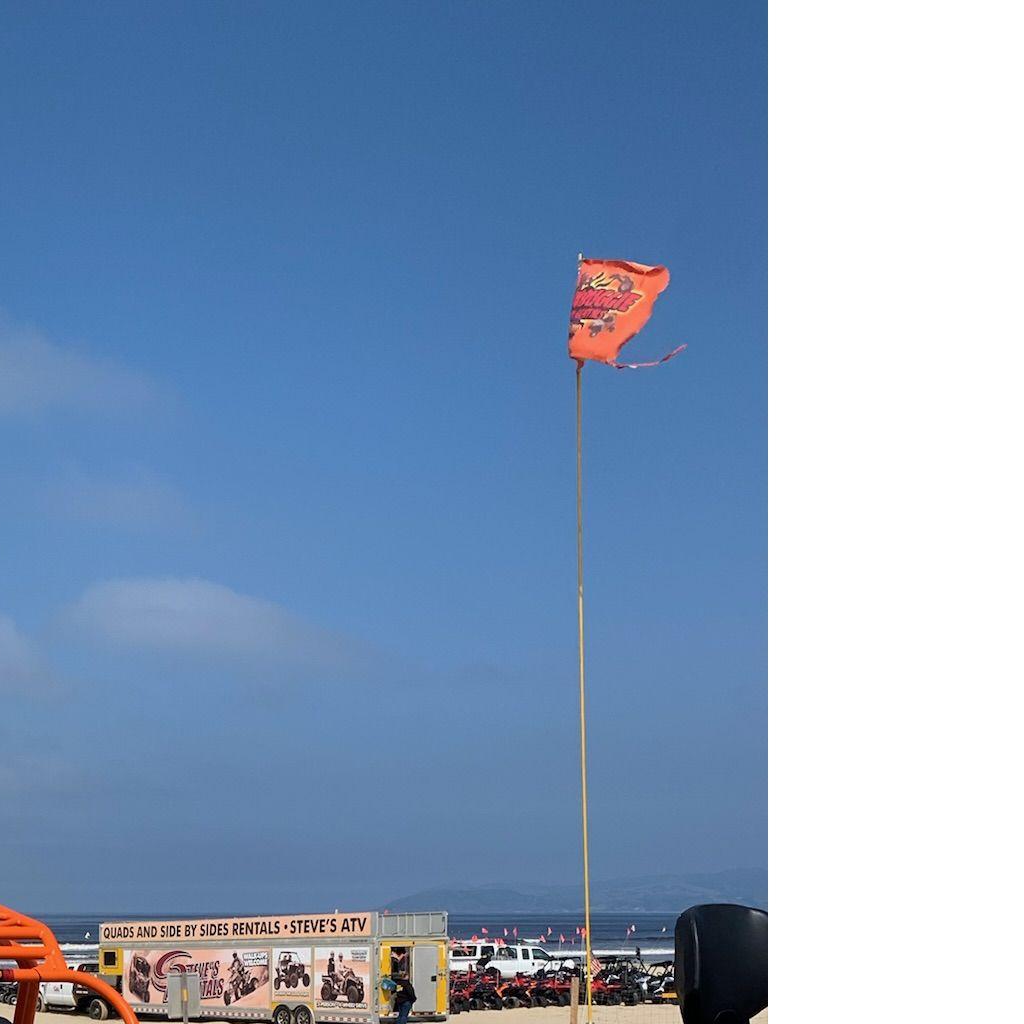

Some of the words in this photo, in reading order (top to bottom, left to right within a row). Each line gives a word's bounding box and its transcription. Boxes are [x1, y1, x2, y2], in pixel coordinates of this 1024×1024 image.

[103, 926, 134, 939] QUADS
[136, 926, 157, 939] AND
[160, 925, 181, 938] SIDE
[184, 924, 197, 937] BY
[200, 922, 229, 937] SIDES
[232, 920, 280, 936] RENTALS
[290, 918, 337, 934] STEVE'S
[341, 917, 367, 933] ATV
